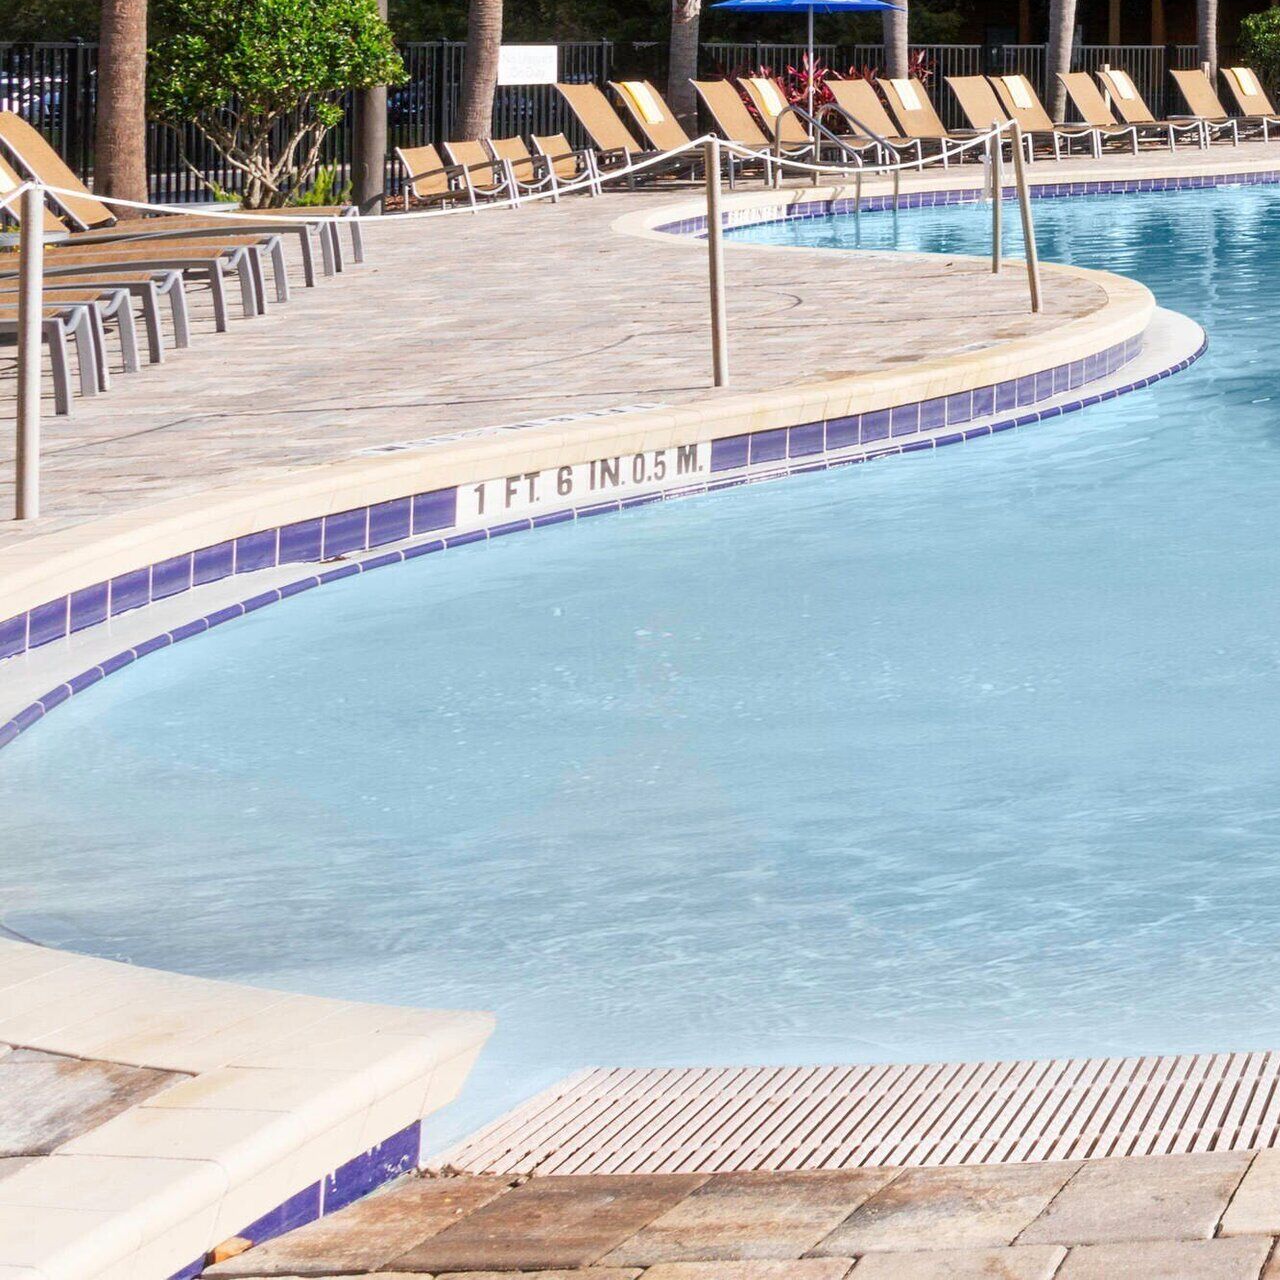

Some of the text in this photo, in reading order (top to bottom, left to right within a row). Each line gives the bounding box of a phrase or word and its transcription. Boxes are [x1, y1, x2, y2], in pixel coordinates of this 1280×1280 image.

[474, 443, 703, 515] 1 FT. 6 IN. 0.5 M.
